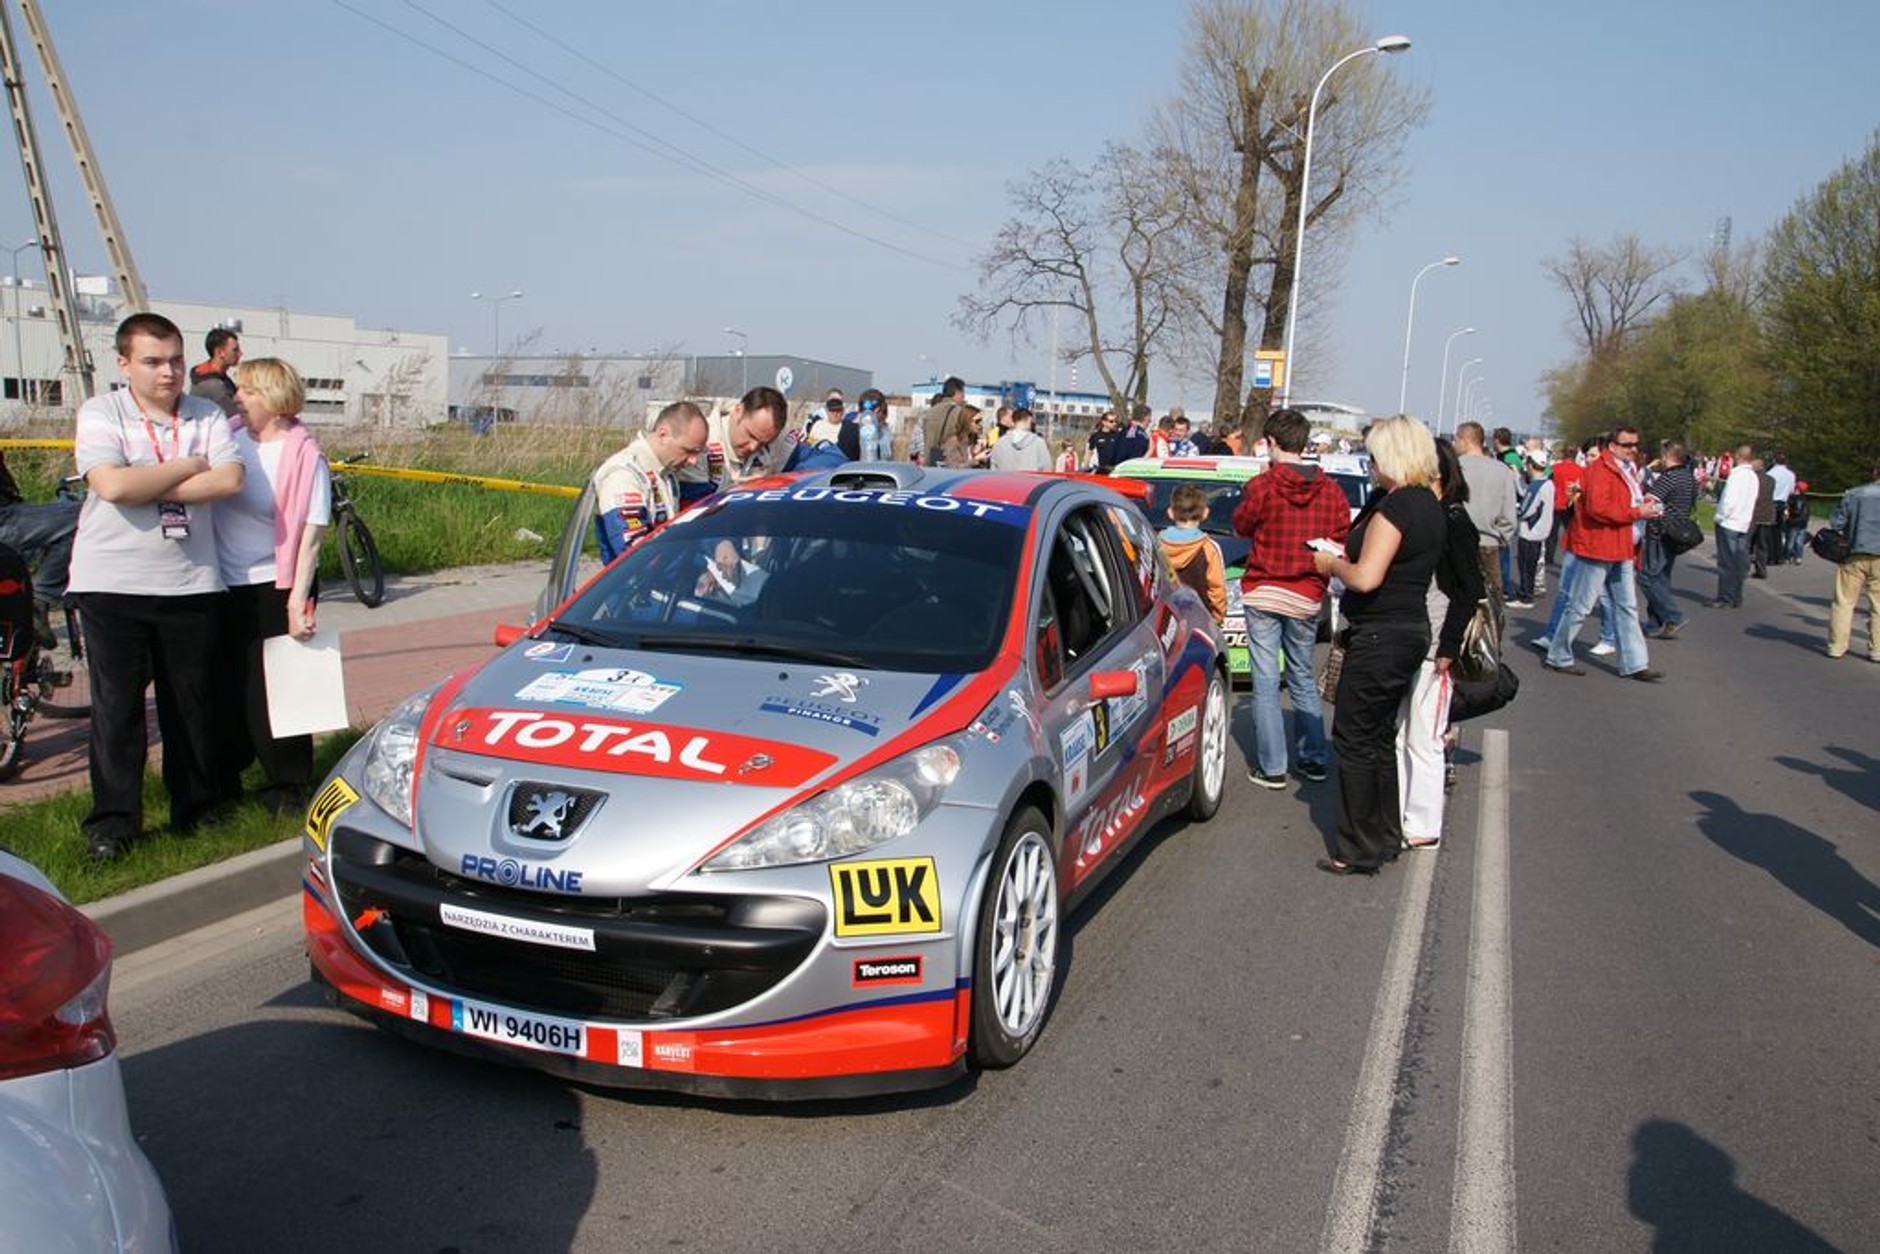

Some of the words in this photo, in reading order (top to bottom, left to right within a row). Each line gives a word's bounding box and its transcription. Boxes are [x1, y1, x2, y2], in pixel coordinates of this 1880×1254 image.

[717, 486, 1004, 518] PEUGEOT
[787, 708, 852, 726] FINANCE
[484, 712, 727, 774] TOTAL
[1075, 774, 1145, 867] TOTAL
[461, 854, 583, 893] PROLINE
[501, 923, 509, 934] Z
[859, 963, 916, 977] Teroson
[468, 1007, 498, 1034] WI
[506, 1016, 581, 1050] 9406H
